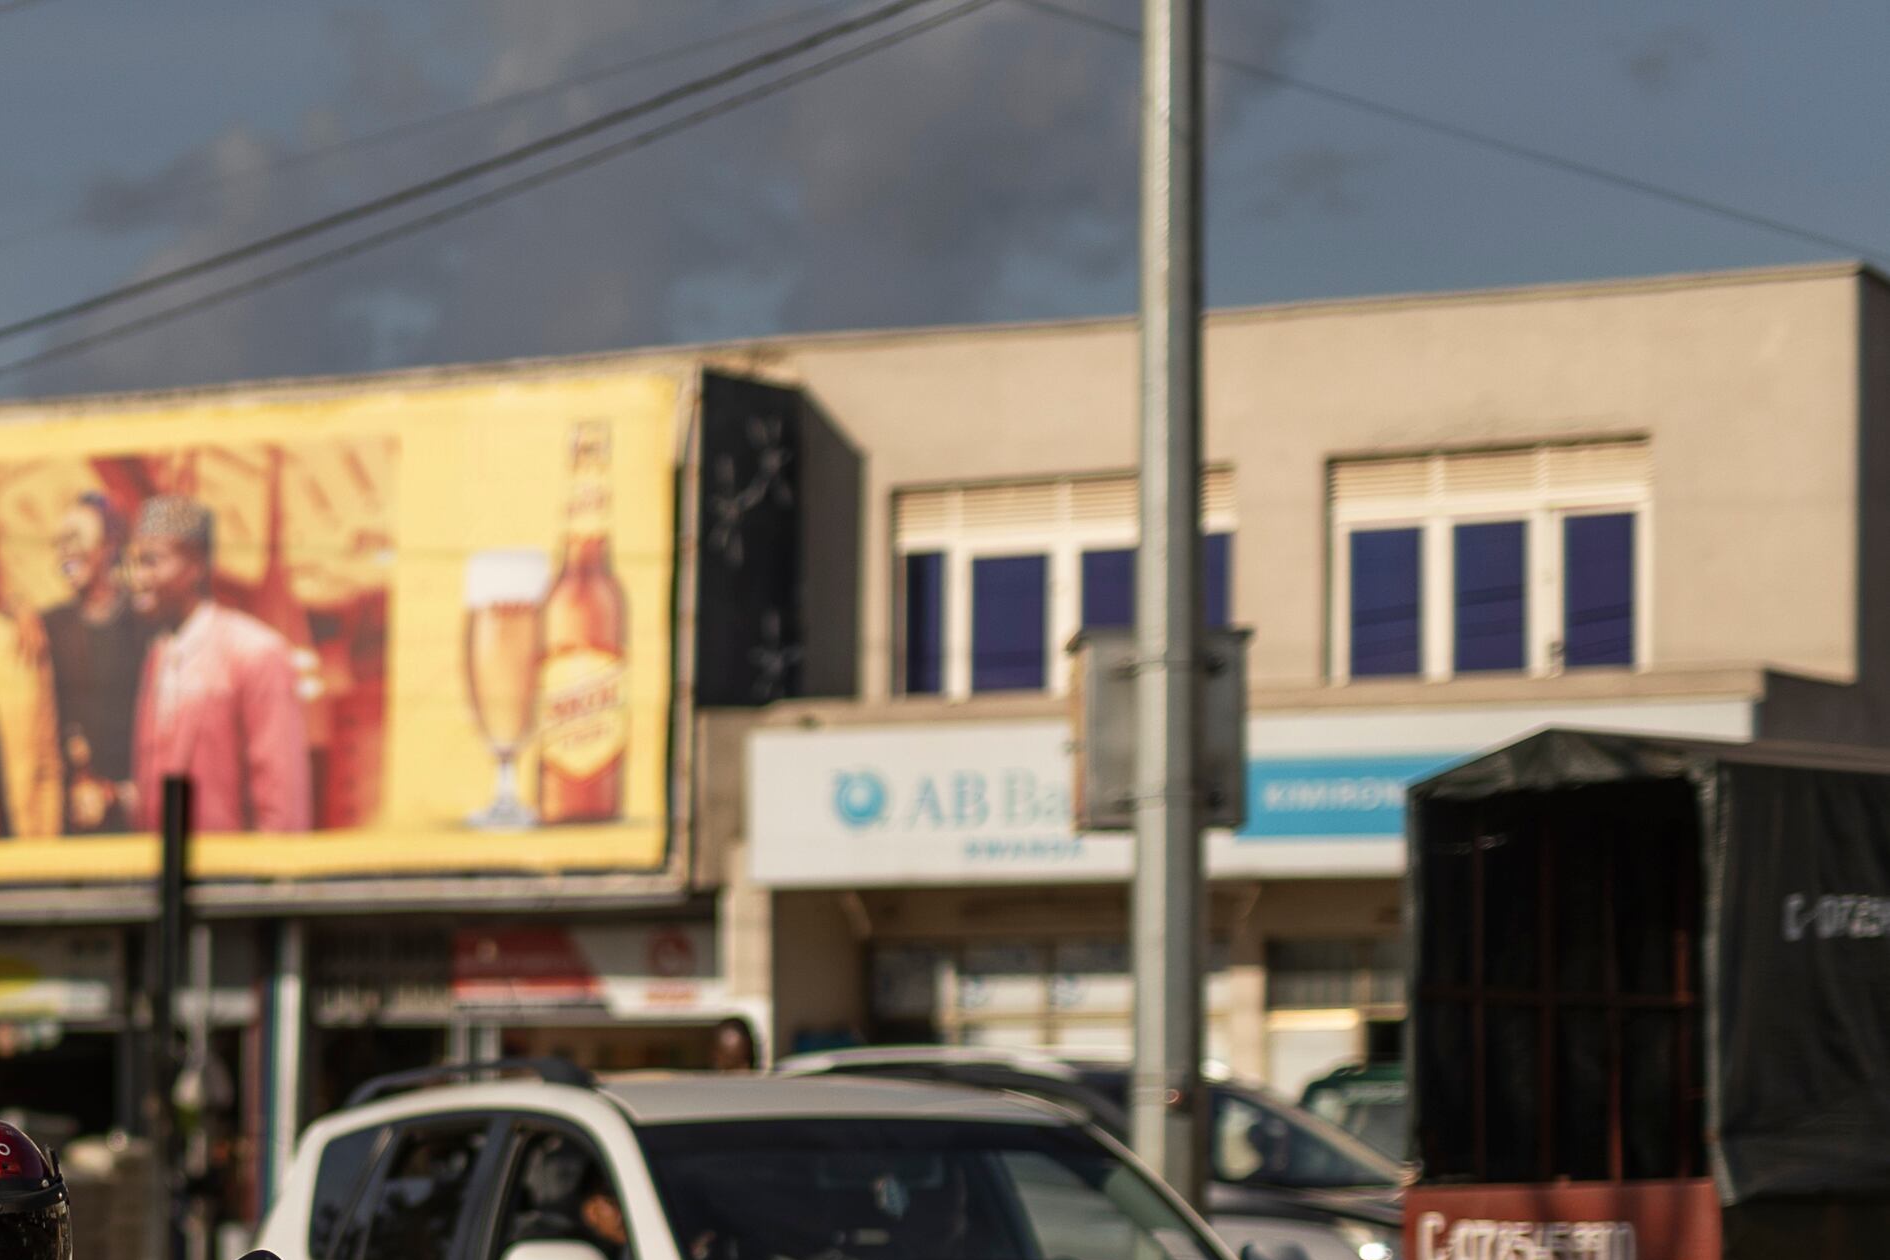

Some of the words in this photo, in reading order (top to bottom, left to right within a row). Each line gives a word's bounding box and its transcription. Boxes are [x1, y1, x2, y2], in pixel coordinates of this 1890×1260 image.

[906, 768, 991, 830] AB
[1002, 767, 1074, 828] Ba
[1265, 776, 1407, 812] KIMIRON
